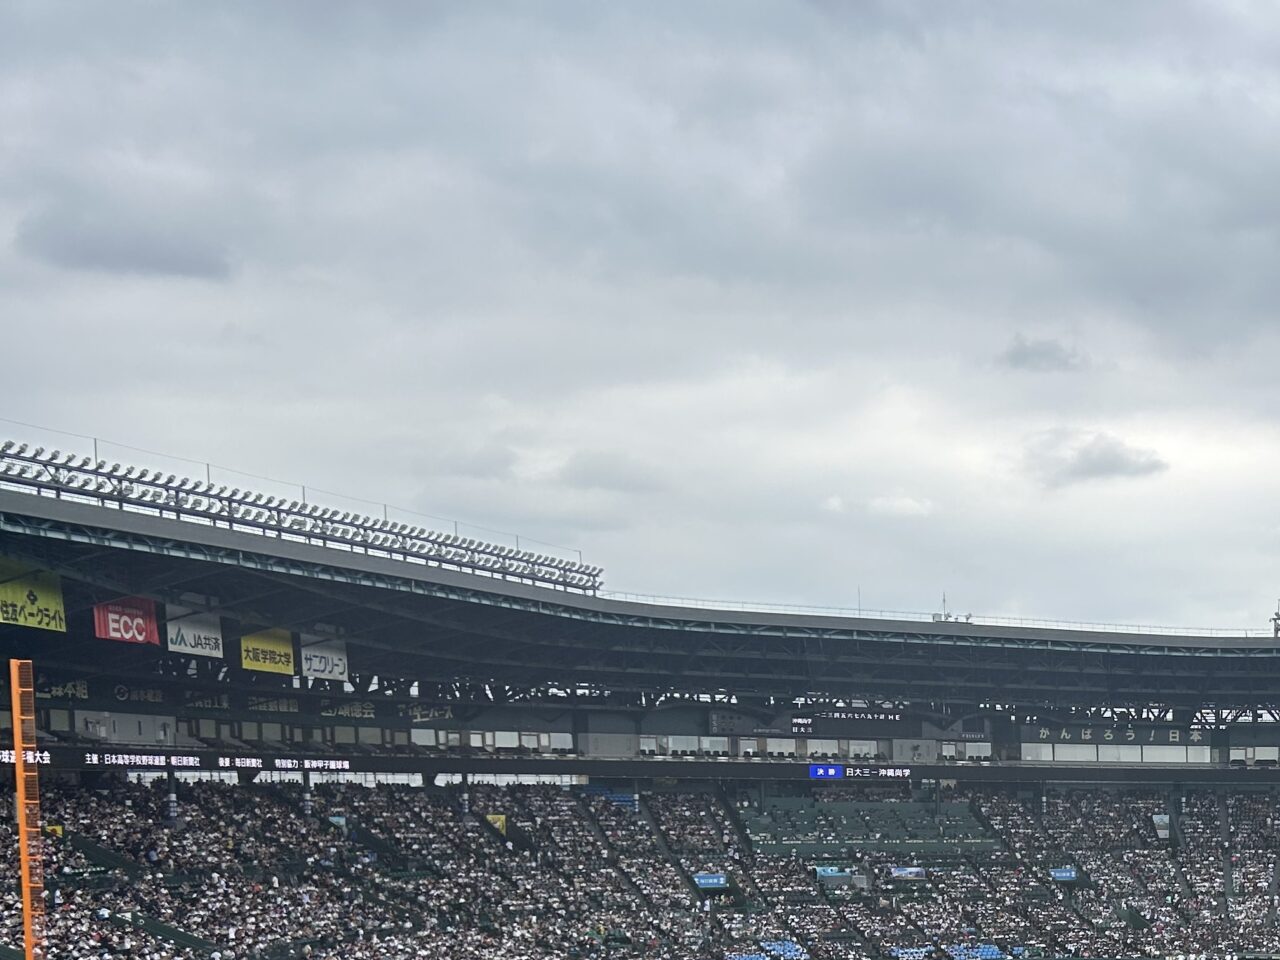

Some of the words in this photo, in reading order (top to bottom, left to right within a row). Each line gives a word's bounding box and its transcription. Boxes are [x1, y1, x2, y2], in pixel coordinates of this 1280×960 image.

[107, 611, 146, 642] ECC
[243, 645, 292, 667] 大阪学院大学
[303, 651, 346, 676] サニクリーン
